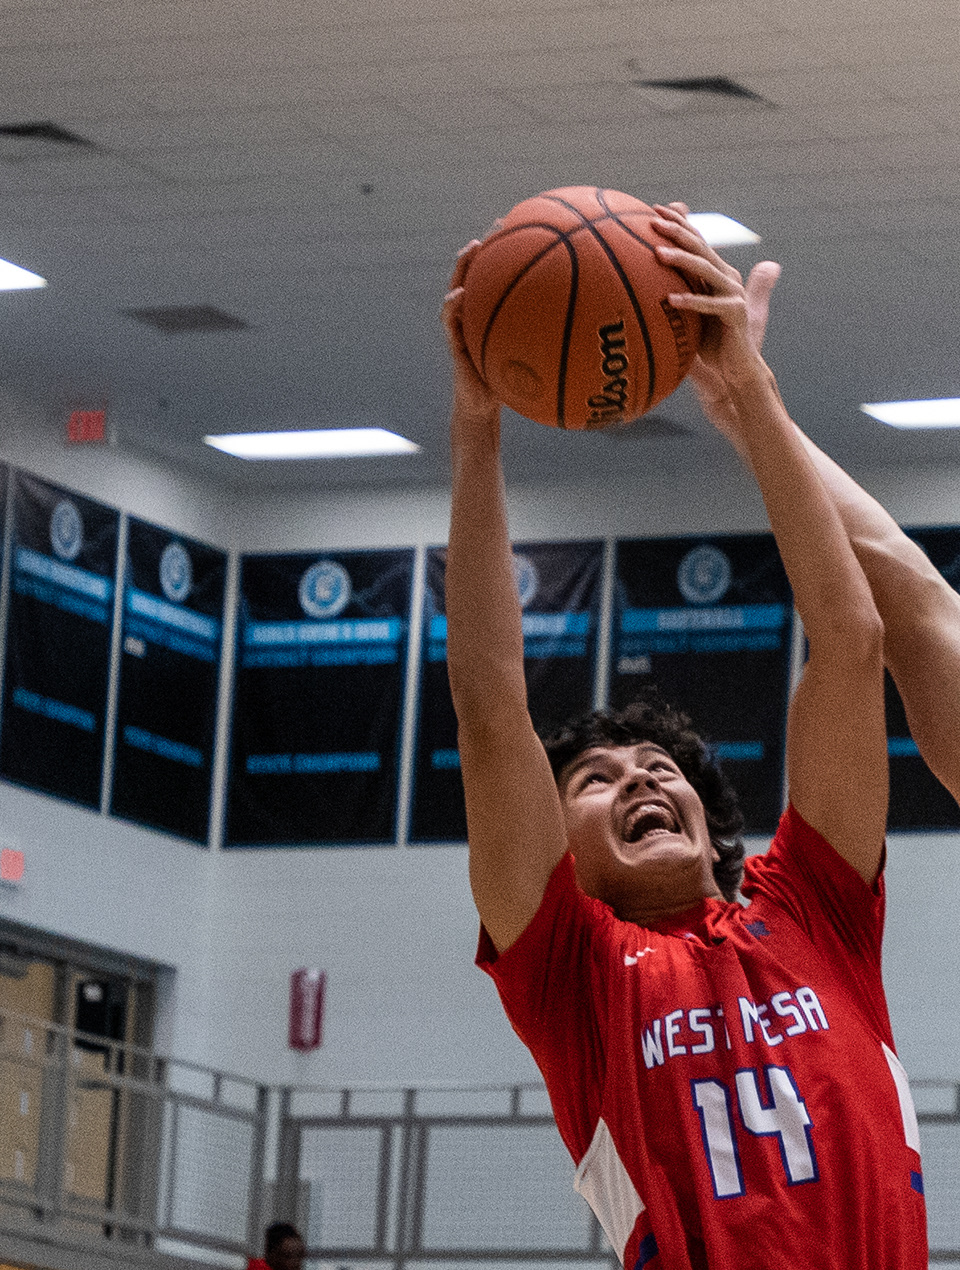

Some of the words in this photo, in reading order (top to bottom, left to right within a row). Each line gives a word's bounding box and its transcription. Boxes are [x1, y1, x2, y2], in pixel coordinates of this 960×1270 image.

[585, 319, 628, 428] ilson
[738, 985, 830, 1047] MESA
[690, 1063, 821, 1200] 14
